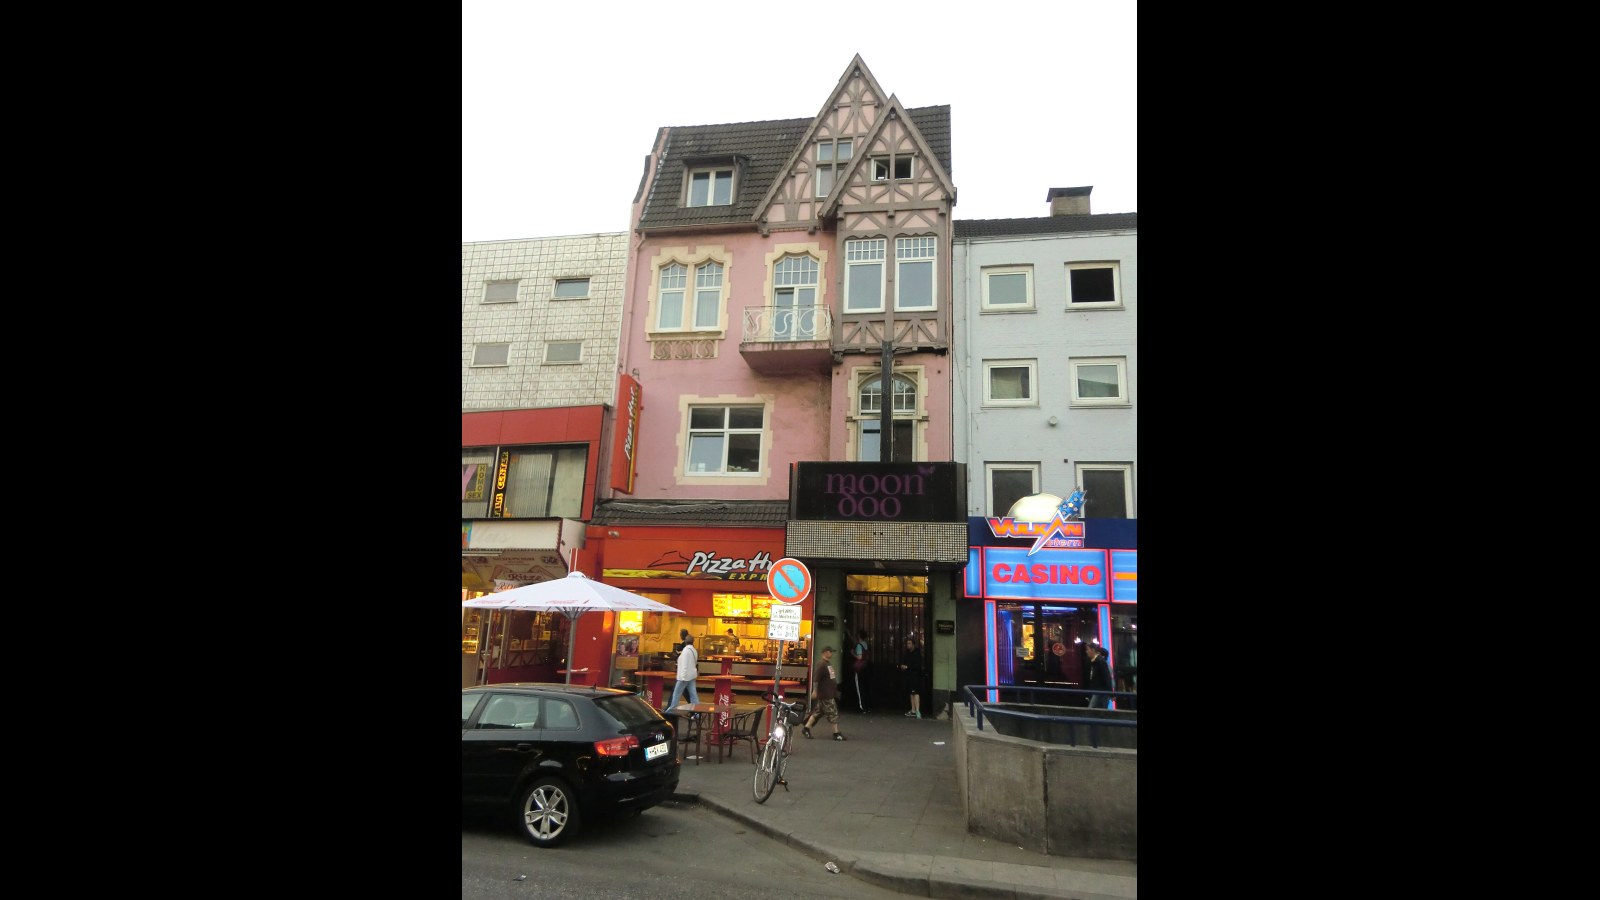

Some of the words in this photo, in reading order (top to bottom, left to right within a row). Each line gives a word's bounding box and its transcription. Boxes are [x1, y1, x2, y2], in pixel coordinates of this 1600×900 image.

[497, 451, 509, 490] CENTER
[824, 473, 926, 495] moon
[838, 486, 901, 518] doo
[686, 551, 746, 575] Pizza
[992, 563, 1103, 586] CASINO
